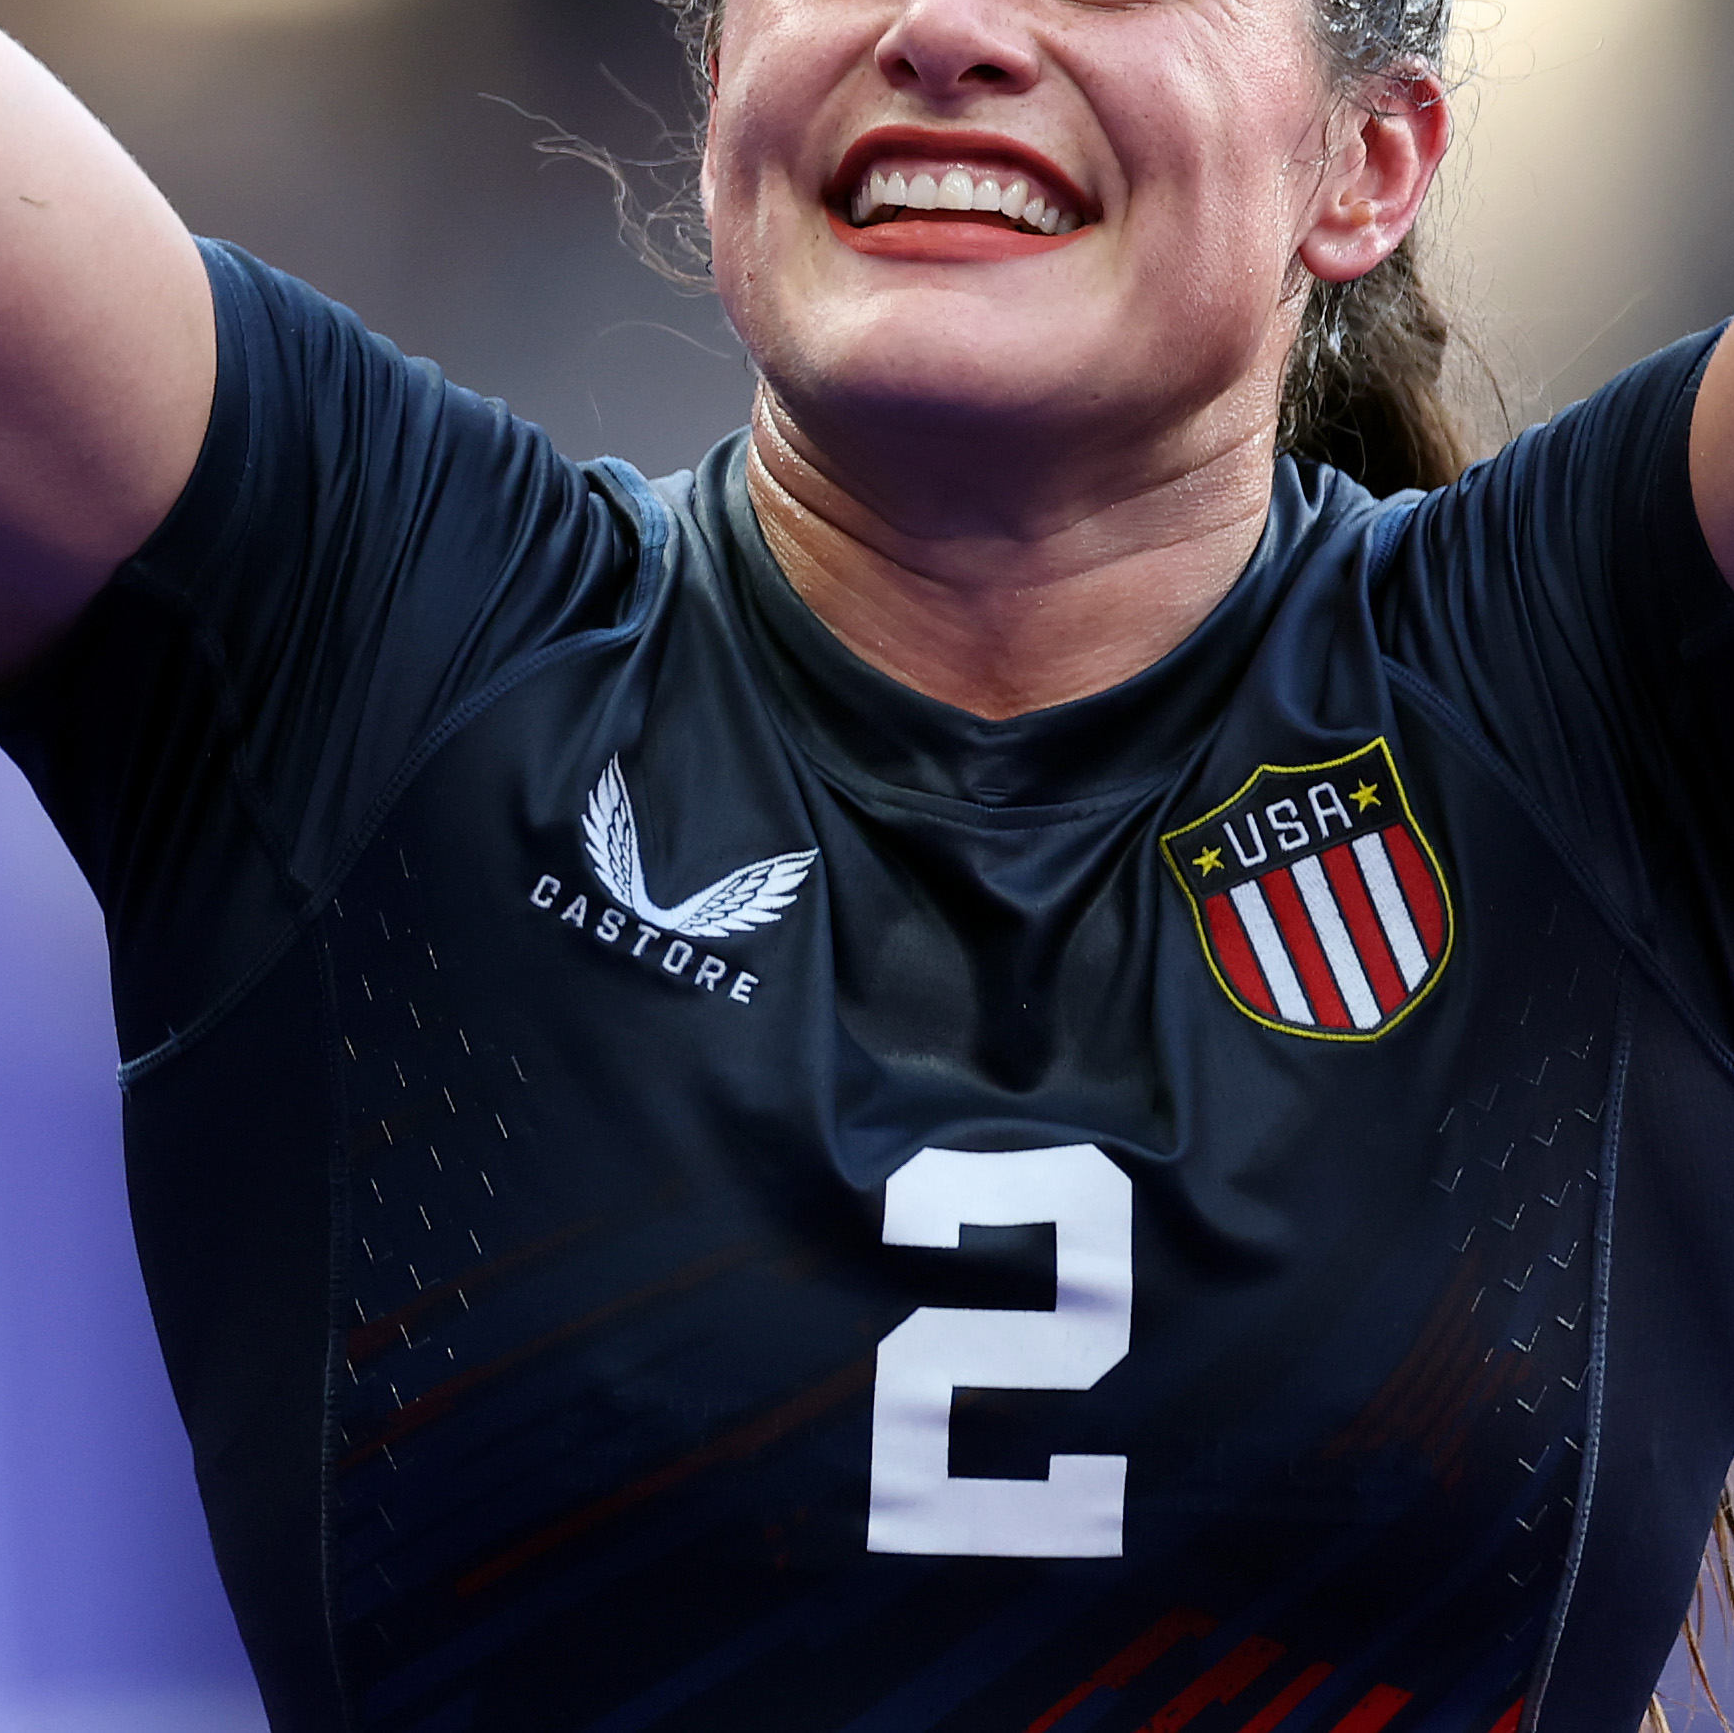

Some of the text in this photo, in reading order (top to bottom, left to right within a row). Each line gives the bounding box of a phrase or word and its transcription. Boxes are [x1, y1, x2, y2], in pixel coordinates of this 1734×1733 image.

[1222, 781, 1353, 867] USA
[529, 874, 759, 1005] CASTORE
[867, 1142, 1133, 1558] 2
